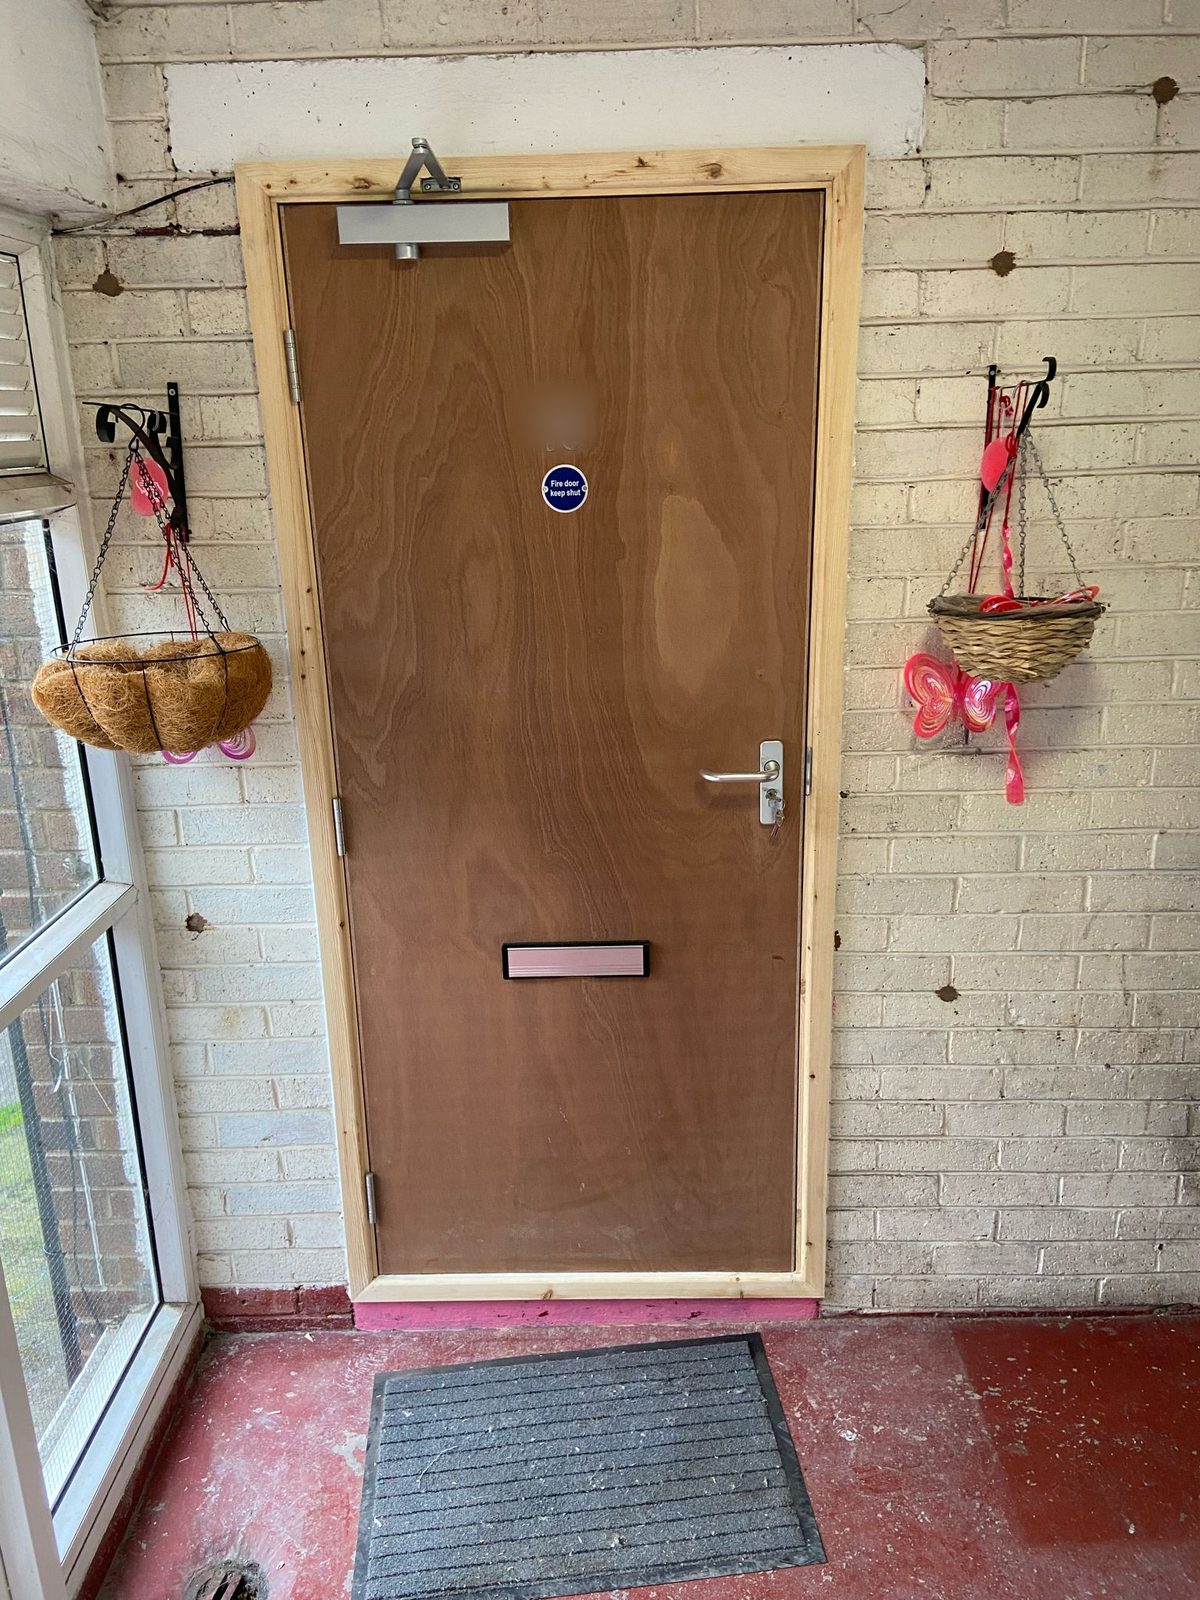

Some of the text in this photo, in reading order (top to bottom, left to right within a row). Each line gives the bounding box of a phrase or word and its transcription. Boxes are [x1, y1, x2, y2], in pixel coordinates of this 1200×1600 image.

[550, 479, 579, 487] Fire door
[550, 488, 581, 498] keep shut
